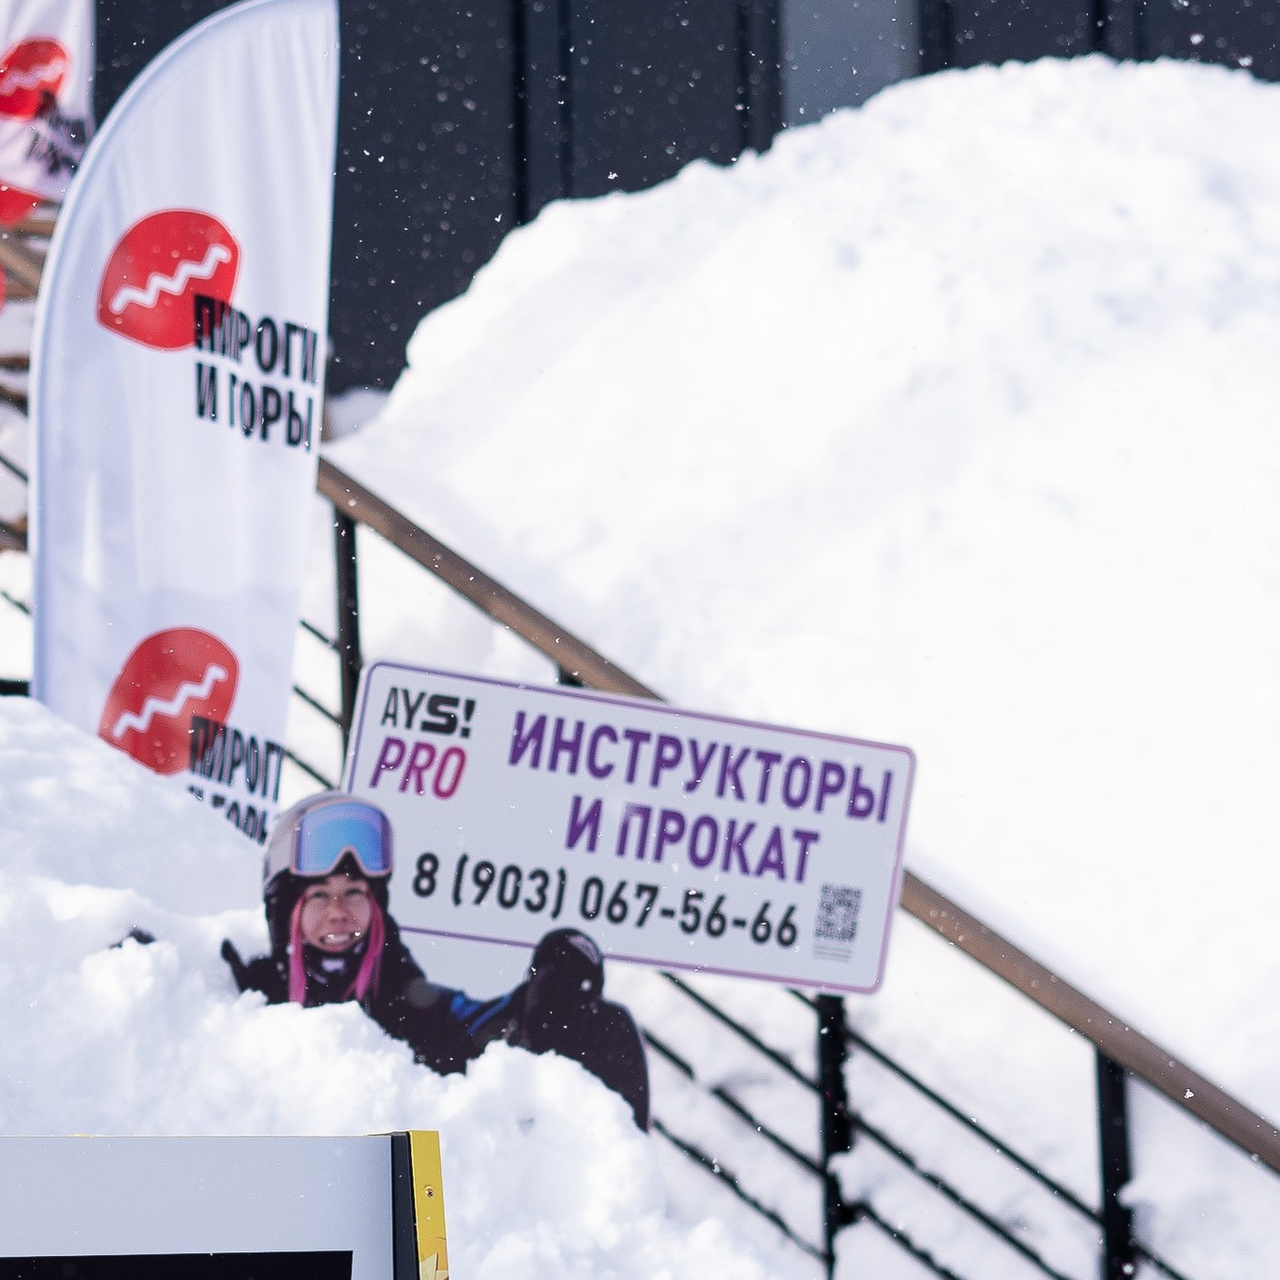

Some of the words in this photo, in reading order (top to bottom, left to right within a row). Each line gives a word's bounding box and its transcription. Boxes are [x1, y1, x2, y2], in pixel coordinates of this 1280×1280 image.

[196, 362, 217, 421] И
[229, 373, 314, 451] ГОРЫ
[381, 686, 476, 738] AYS!
[370, 736, 467, 799] PRO
[508, 710, 896, 822] ИНСТРУКТОРЫ
[566, 795, 603, 852] И
[616, 801, 820, 883] ПРОКАТ
[413, 853, 439, 898] 8
[452, 853, 567, 920] (903)
[580, 876, 798, 948] 067-56-66
